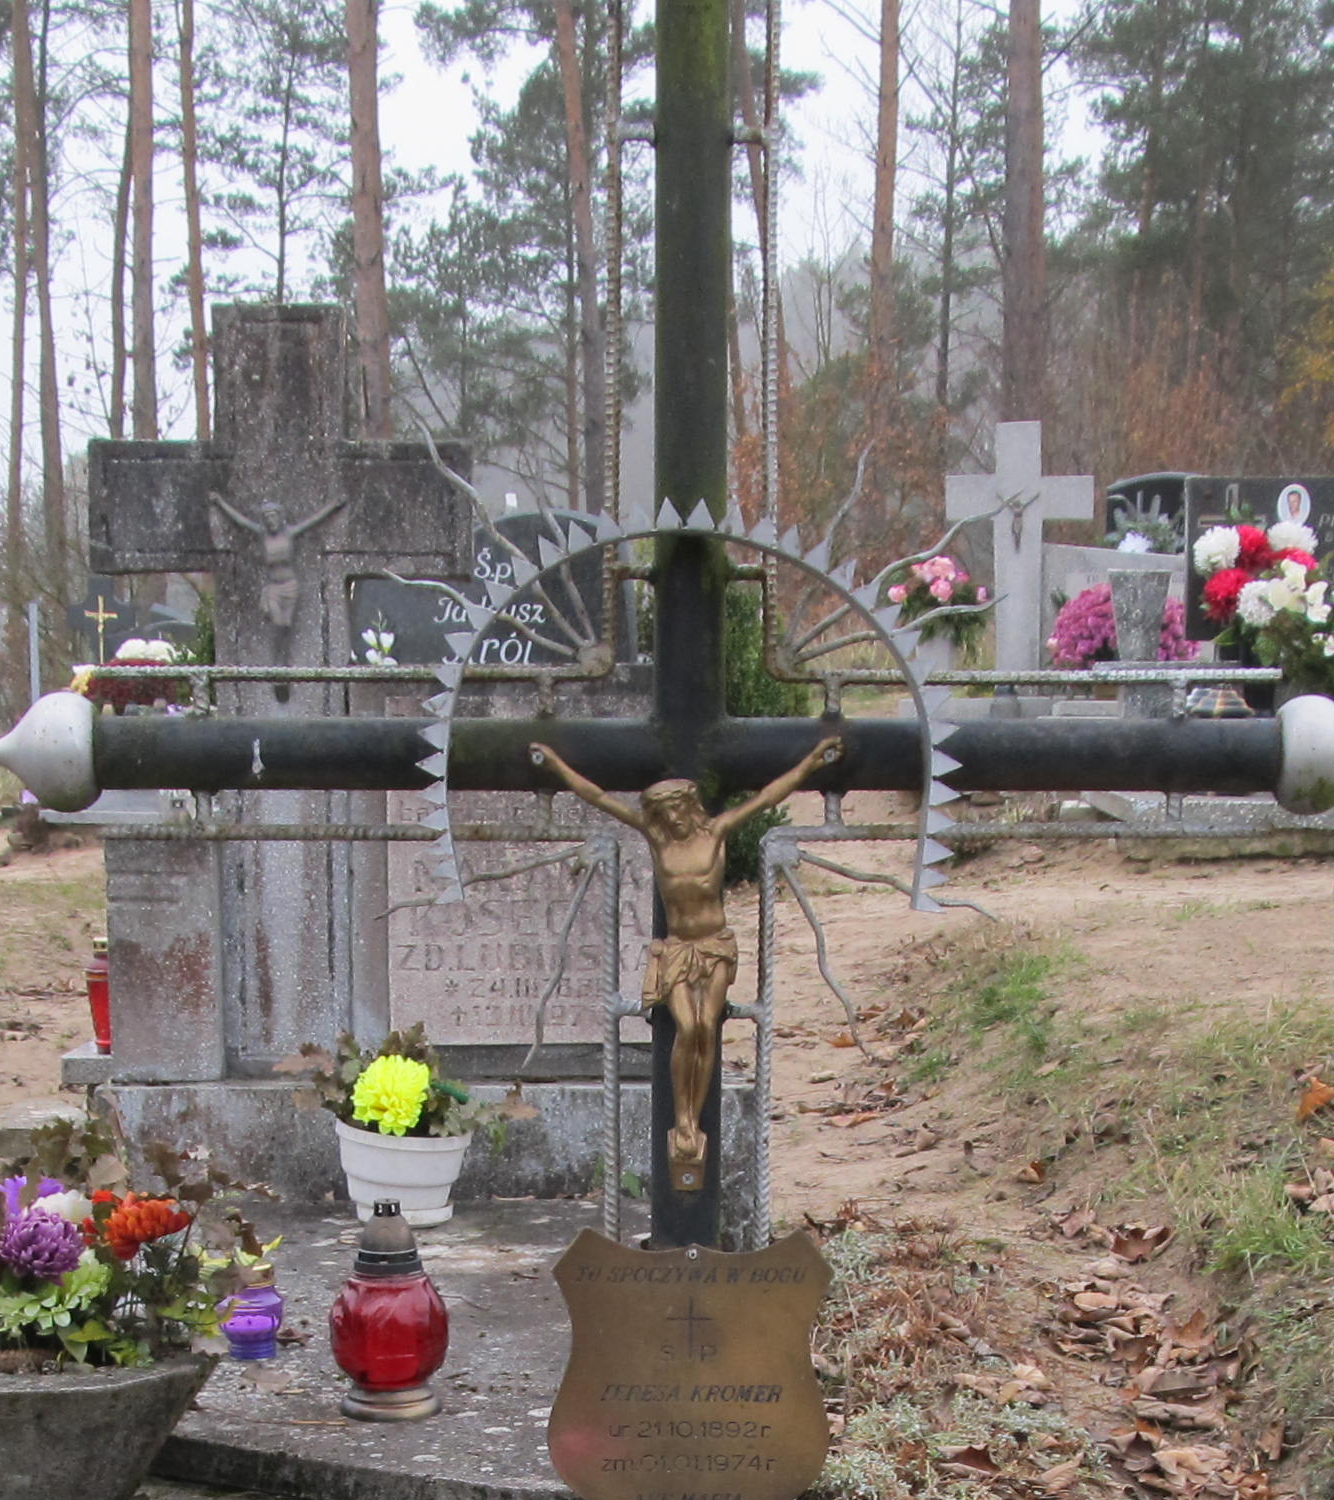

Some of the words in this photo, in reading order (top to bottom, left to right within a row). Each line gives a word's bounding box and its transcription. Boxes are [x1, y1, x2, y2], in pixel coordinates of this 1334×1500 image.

[607, 1266, 717, 1284] SPOCZYWA
[725, 1266, 745, 1284] W
[749, 1266, 808, 1284] BOGU
[600, 1384, 681, 1402] TERESA
[690, 1384, 784, 1403] KROMER
